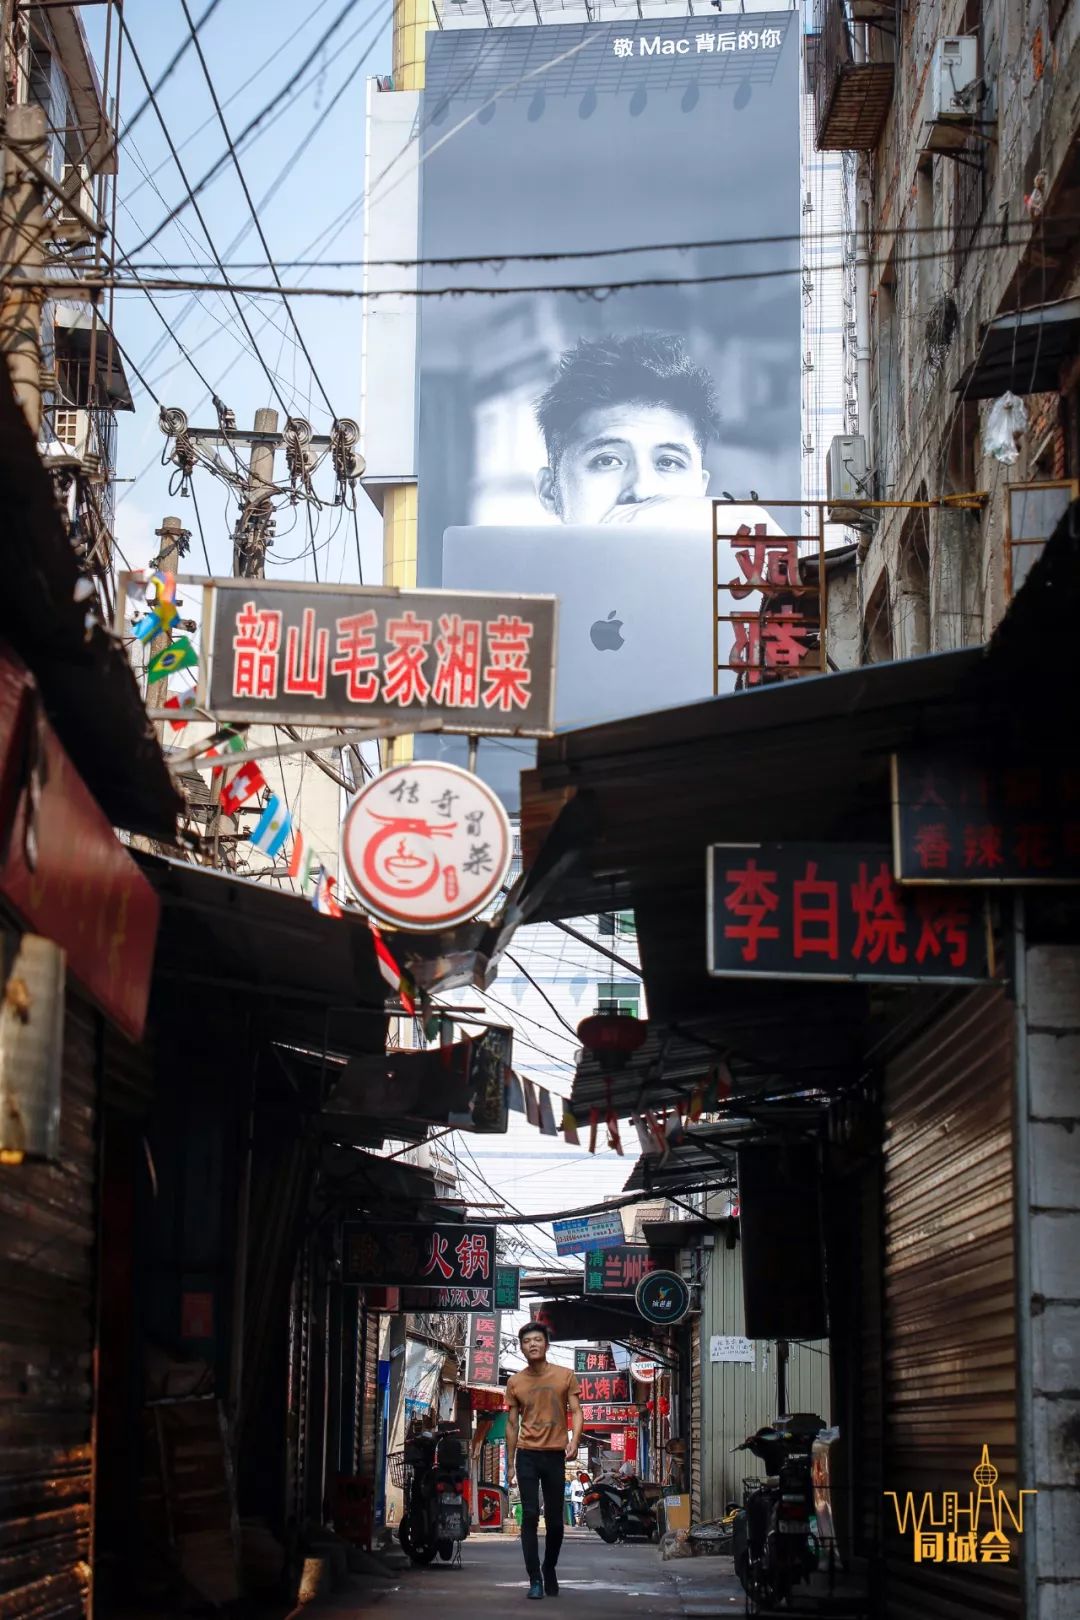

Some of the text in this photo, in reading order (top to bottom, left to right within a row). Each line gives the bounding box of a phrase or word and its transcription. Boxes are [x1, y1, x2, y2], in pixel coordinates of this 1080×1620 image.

[613, 28, 782, 58] 敬 Mac 背后的你
[232, 601, 534, 711] 韶山毛家湘菜
